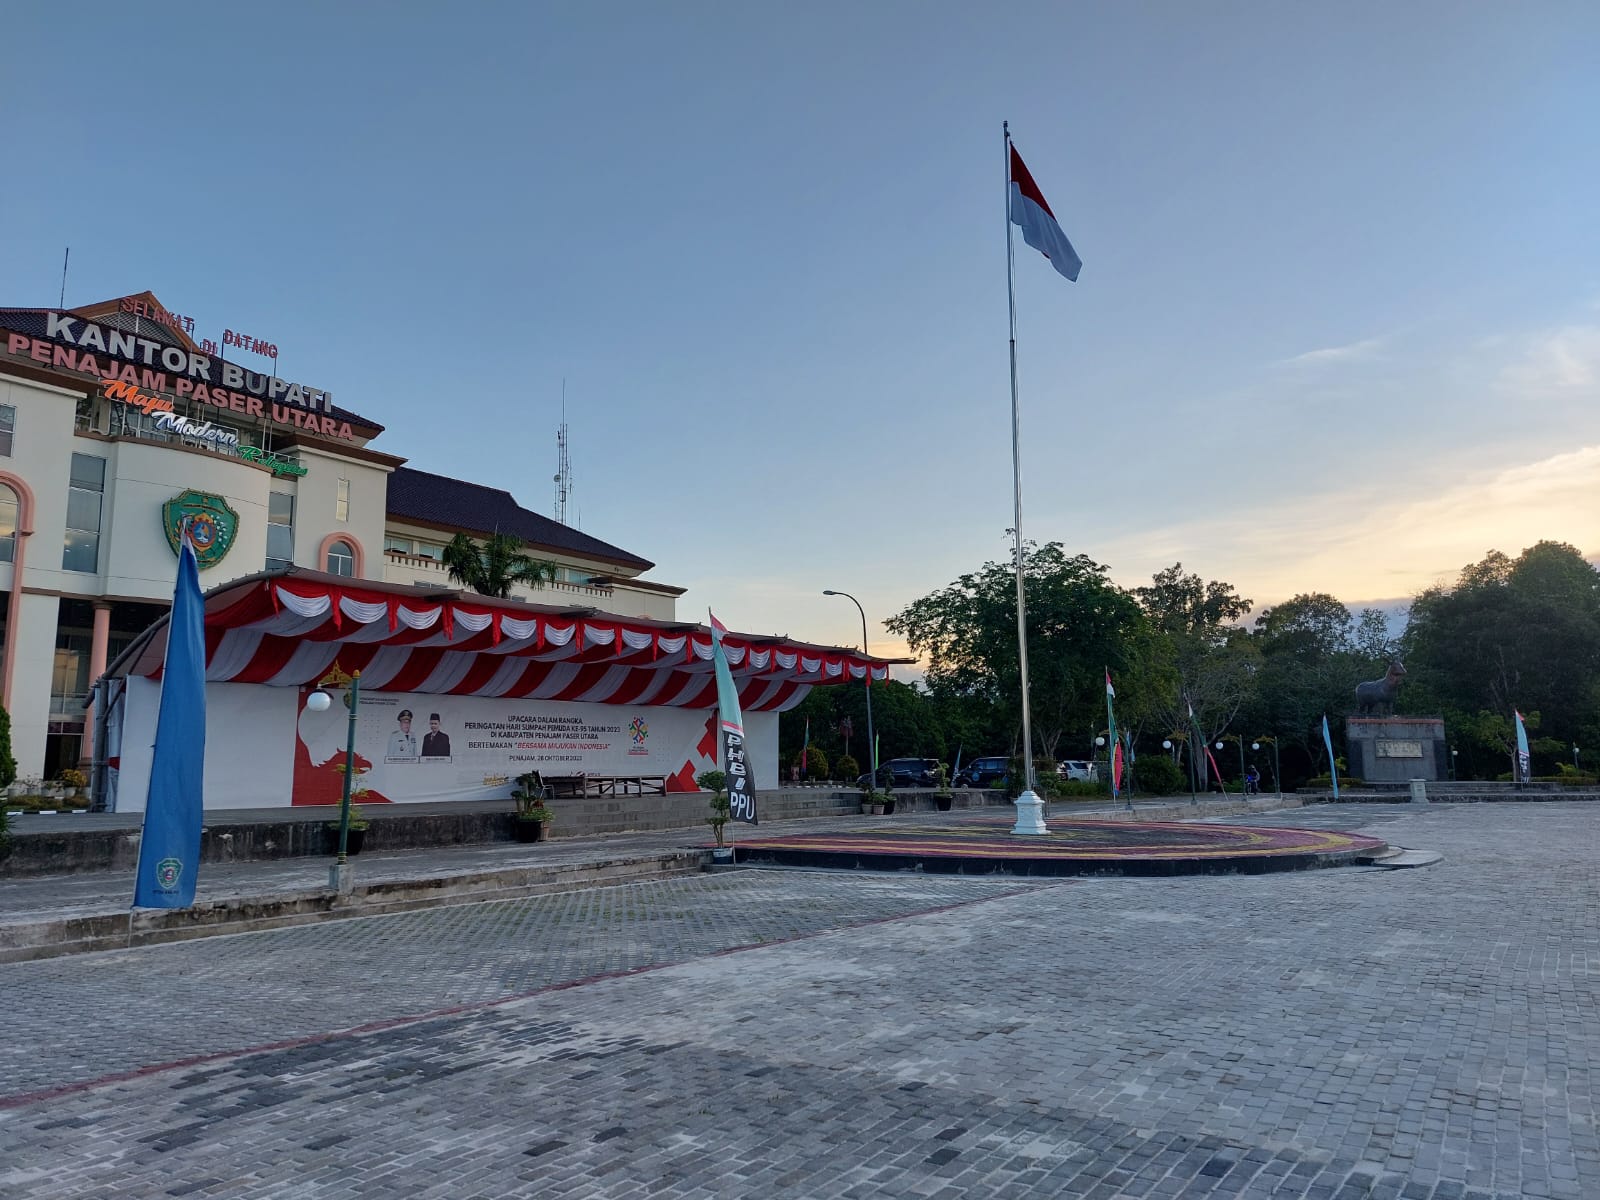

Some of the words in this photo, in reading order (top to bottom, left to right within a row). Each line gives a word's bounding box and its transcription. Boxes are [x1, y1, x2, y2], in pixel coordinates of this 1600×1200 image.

[121, 297, 194, 332] SELAMAT
[200, 338, 218, 355] DI
[223, 328, 278, 359] DATANG
[46, 311, 211, 380] KANTOR
[222, 362, 332, 412] BUPATI
[7, 332, 166, 393] PENAJAM
[176, 377, 264, 417] PASER
[272, 403, 353, 440] UTARA
[102, 379, 175, 415] Maju
[151, 411, 239, 448] Modern
[559, 717, 583, 725] RANGKA
[468, 741, 513, 749] BERTEMAKAN
[727, 734, 747, 790] PHBI
[730, 791, 755, 820] PPU
